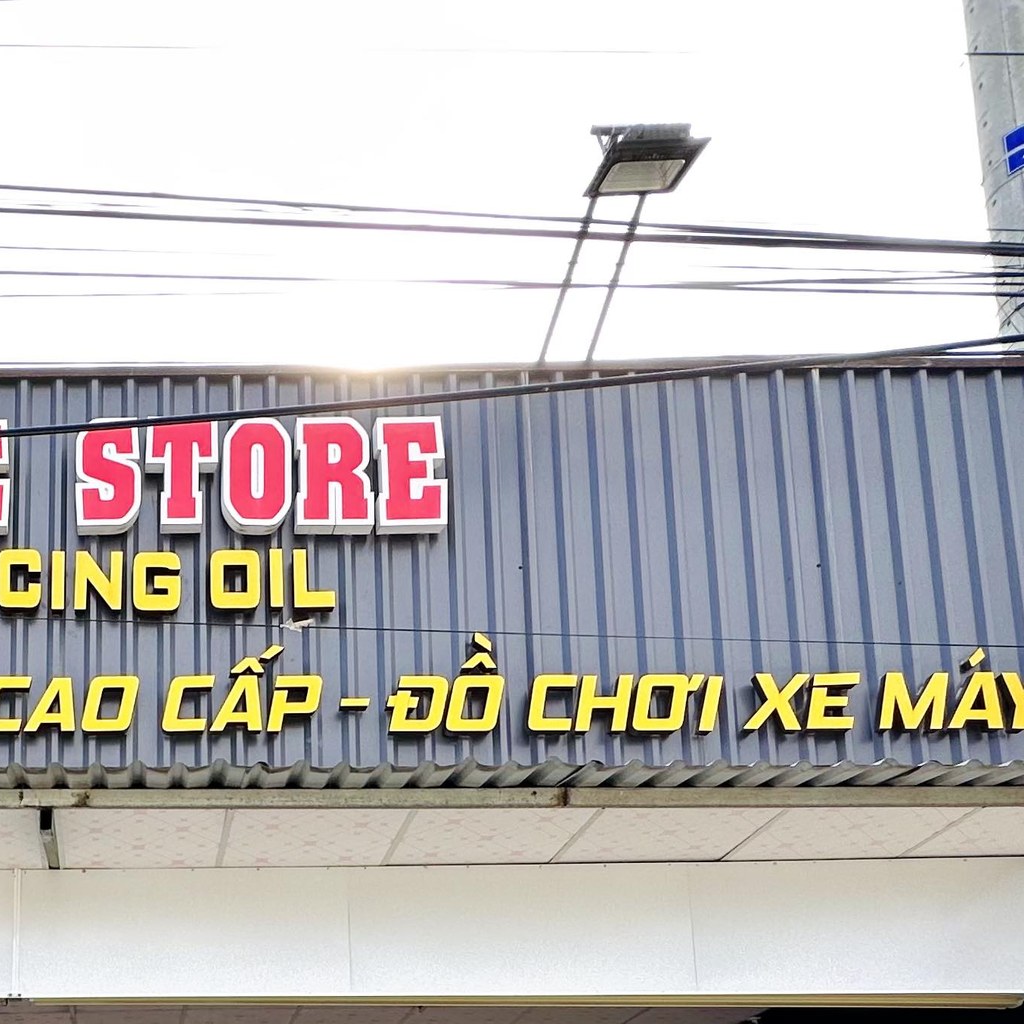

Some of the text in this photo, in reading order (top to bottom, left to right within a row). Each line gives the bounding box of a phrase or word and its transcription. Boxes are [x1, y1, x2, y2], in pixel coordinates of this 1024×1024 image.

[76, 416, 449, 535] STORE
[210, 547, 337, 609] OIL
[161, 645, 322, 732] CẤP
[387, 633, 505, 732] ĐỒ
[529, 673, 722, 731] CHƠI
[747, 672, 860, 731] XE
